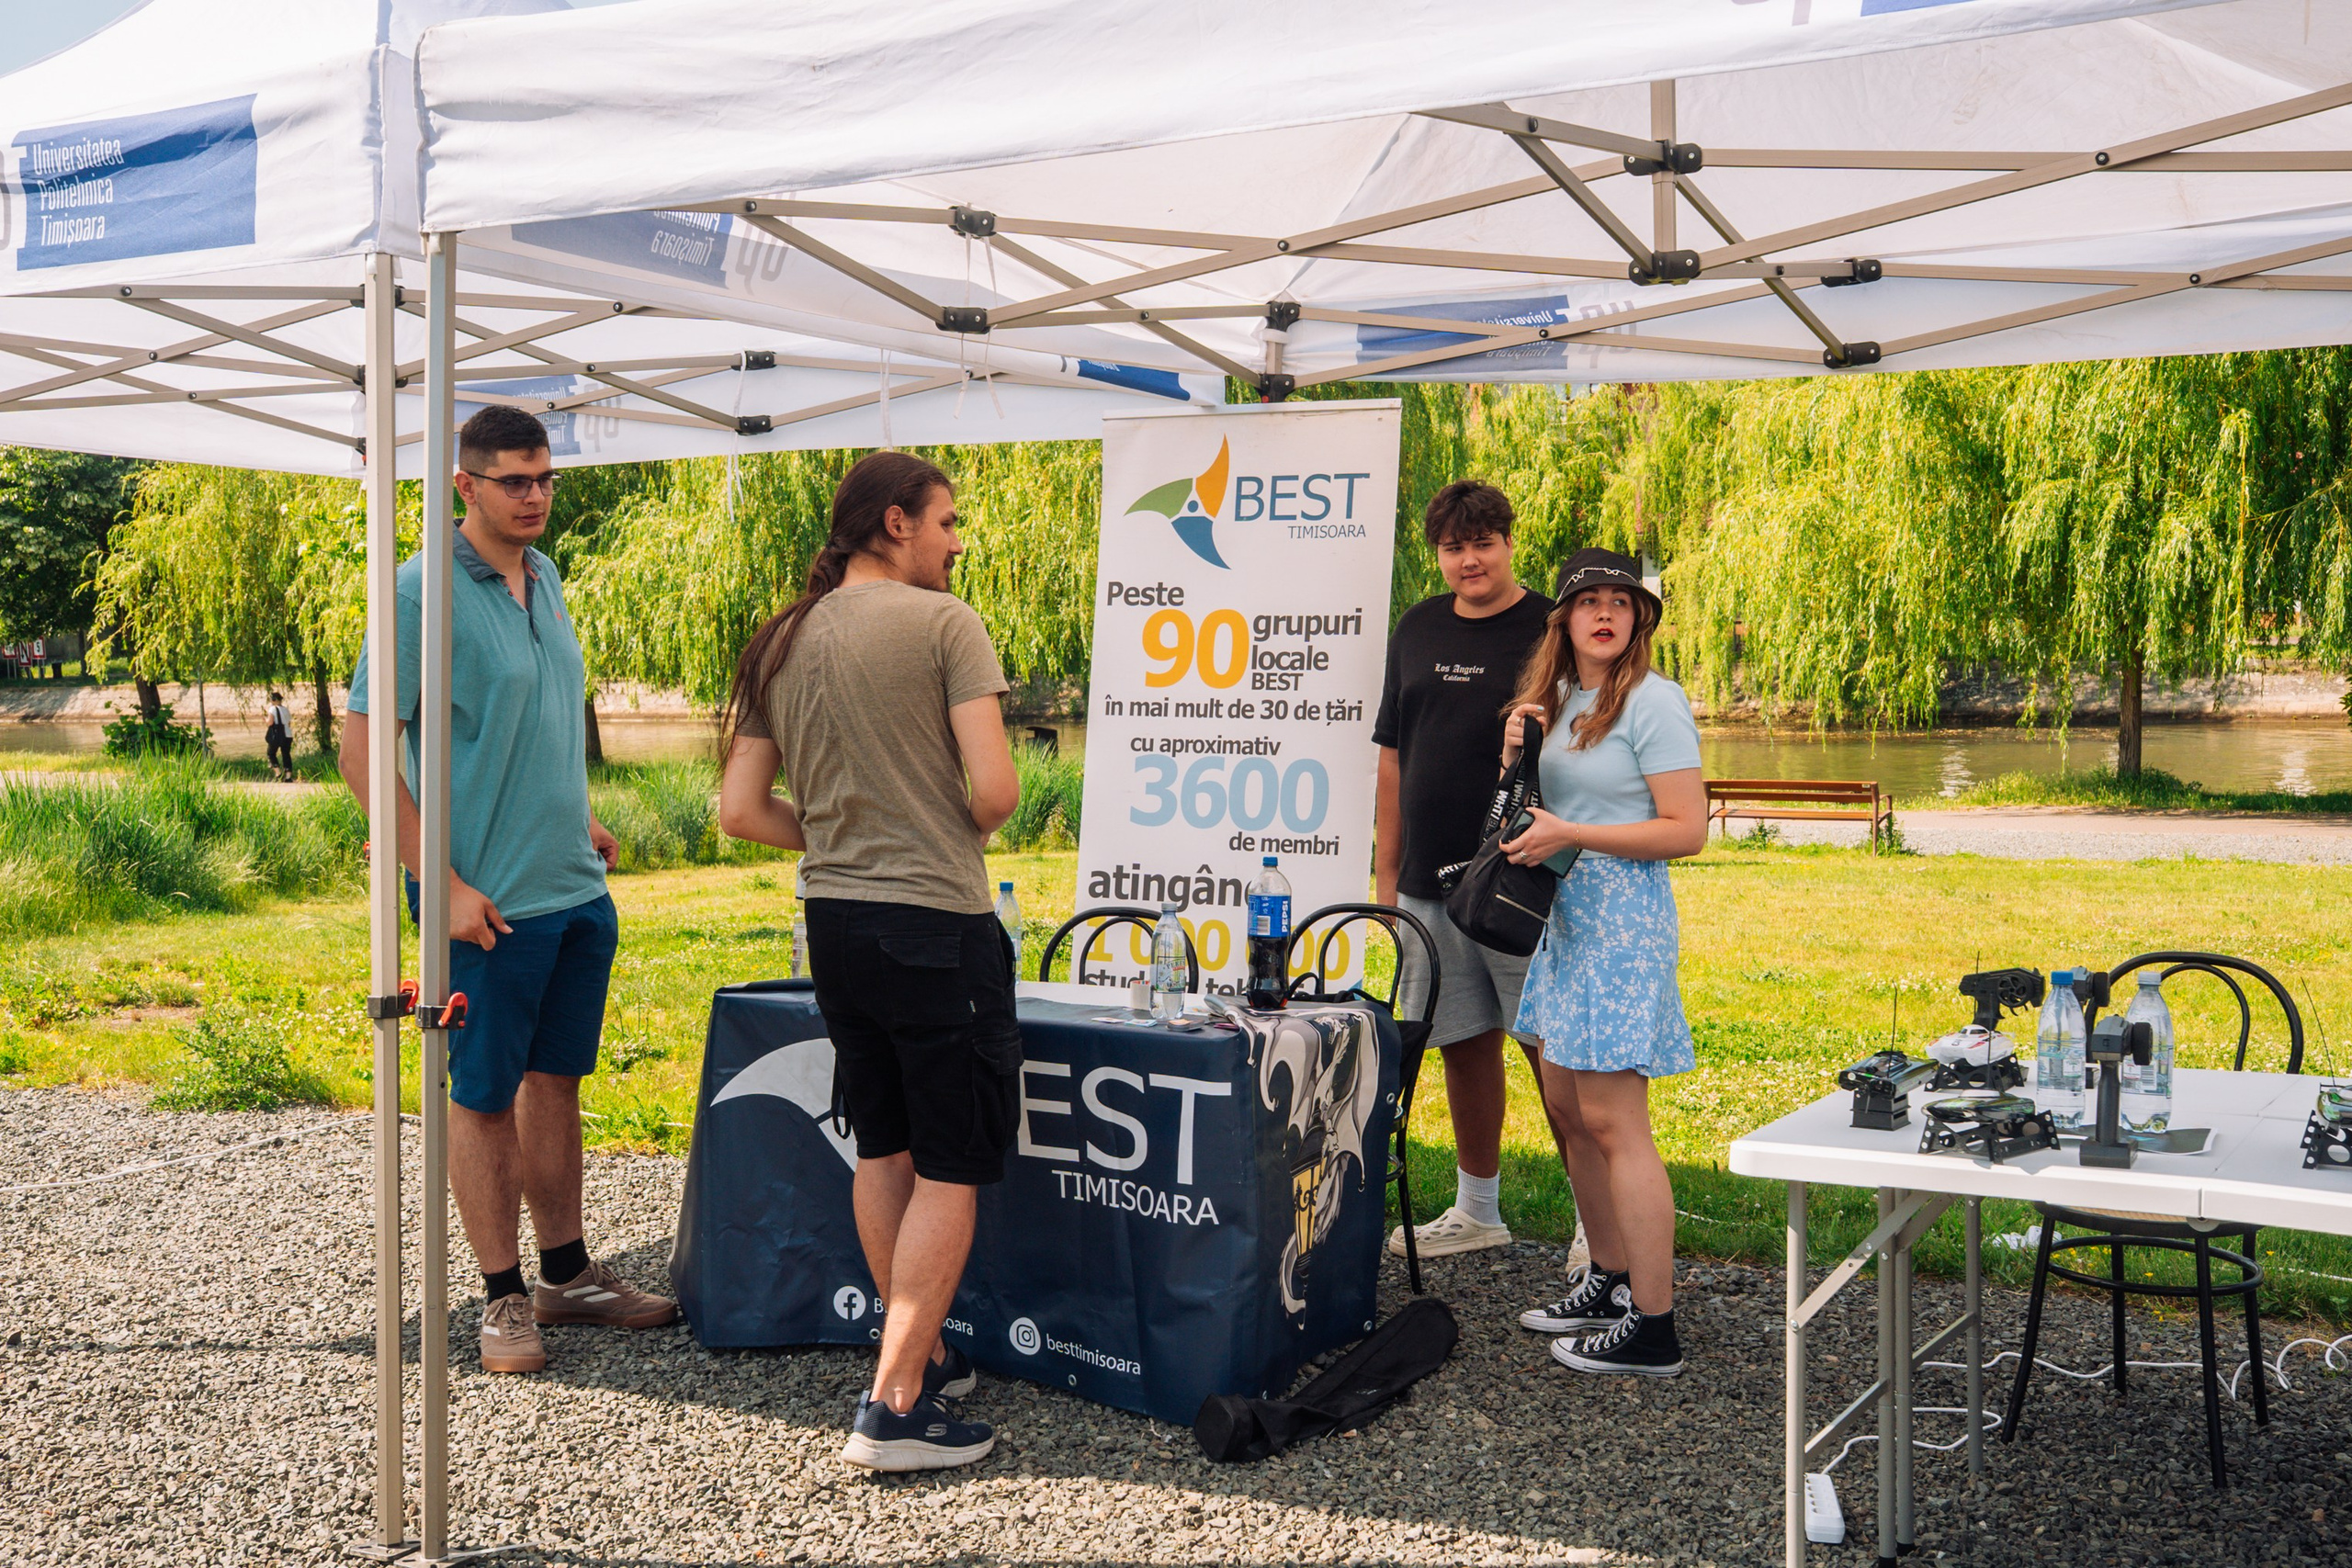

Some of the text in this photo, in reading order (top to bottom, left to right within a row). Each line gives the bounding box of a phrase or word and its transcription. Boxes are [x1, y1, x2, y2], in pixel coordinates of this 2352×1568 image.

[33, 137, 124, 175] Universitatea
[37, 173, 114, 211] Politehnica
[40, 212, 106, 248] Timișoara
[1235, 472, 1370, 522] BEST
[1288, 525, 1366, 539] TIMISOARA
[1107, 581, 1184, 606] Peste
[1252, 608, 1363, 642] grupuri
[1142, 609, 1250, 689] 90
[1251, 645, 1329, 671] locale
[1251, 672, 1303, 691] BEST
[1434, 663, 1485, 675] Los Angeles
[1105, 694, 1363, 726] în mai mult de 30 de țări
[1130, 735, 1281, 758] cu aproximativ
[1129, 754, 1329, 833] 3600
[1229, 831, 1340, 855] de membri
[1018, 1059, 1232, 1185] EST
[1052, 1169, 1219, 1226] TIMISOARA
[1046, 1334, 1141, 1376] besttimisoara
